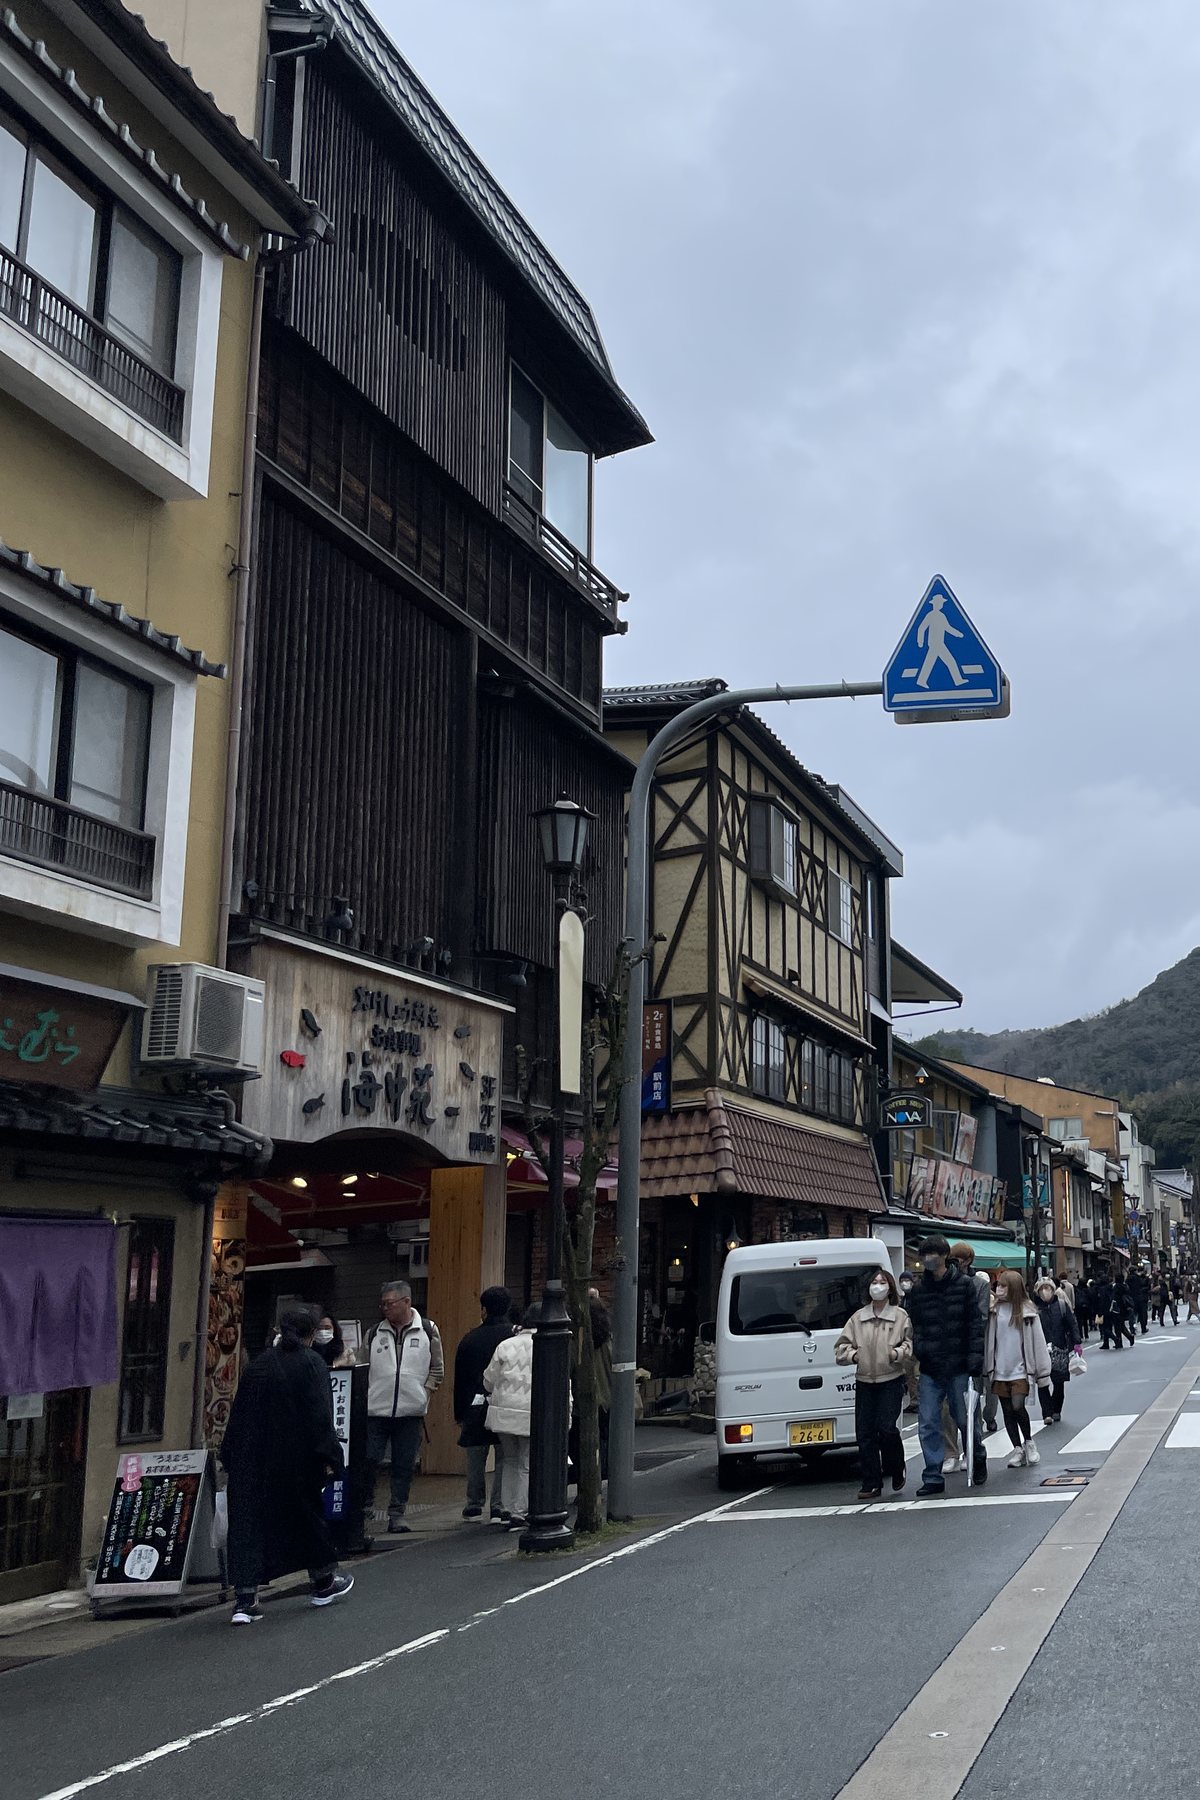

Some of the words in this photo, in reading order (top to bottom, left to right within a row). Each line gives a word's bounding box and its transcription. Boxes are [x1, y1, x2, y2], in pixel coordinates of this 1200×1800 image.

[653, 1010, 664, 1021] 2F
[342, 1052, 437, 1126] 海中苑
[652, 1072, 662, 1101] 駅前店
[885, 1099, 907, 1111] COFFEE
[480, 1104, 496, 1130] 2F
[886, 1111, 924, 1124] NOVA
[331, 1377, 347, 1393] 2F
[336, 1394, 346, 1438] お食事処
[799, 1429, 830, 1443] 26-61
[332, 1480, 343, 1513] 駅前店
